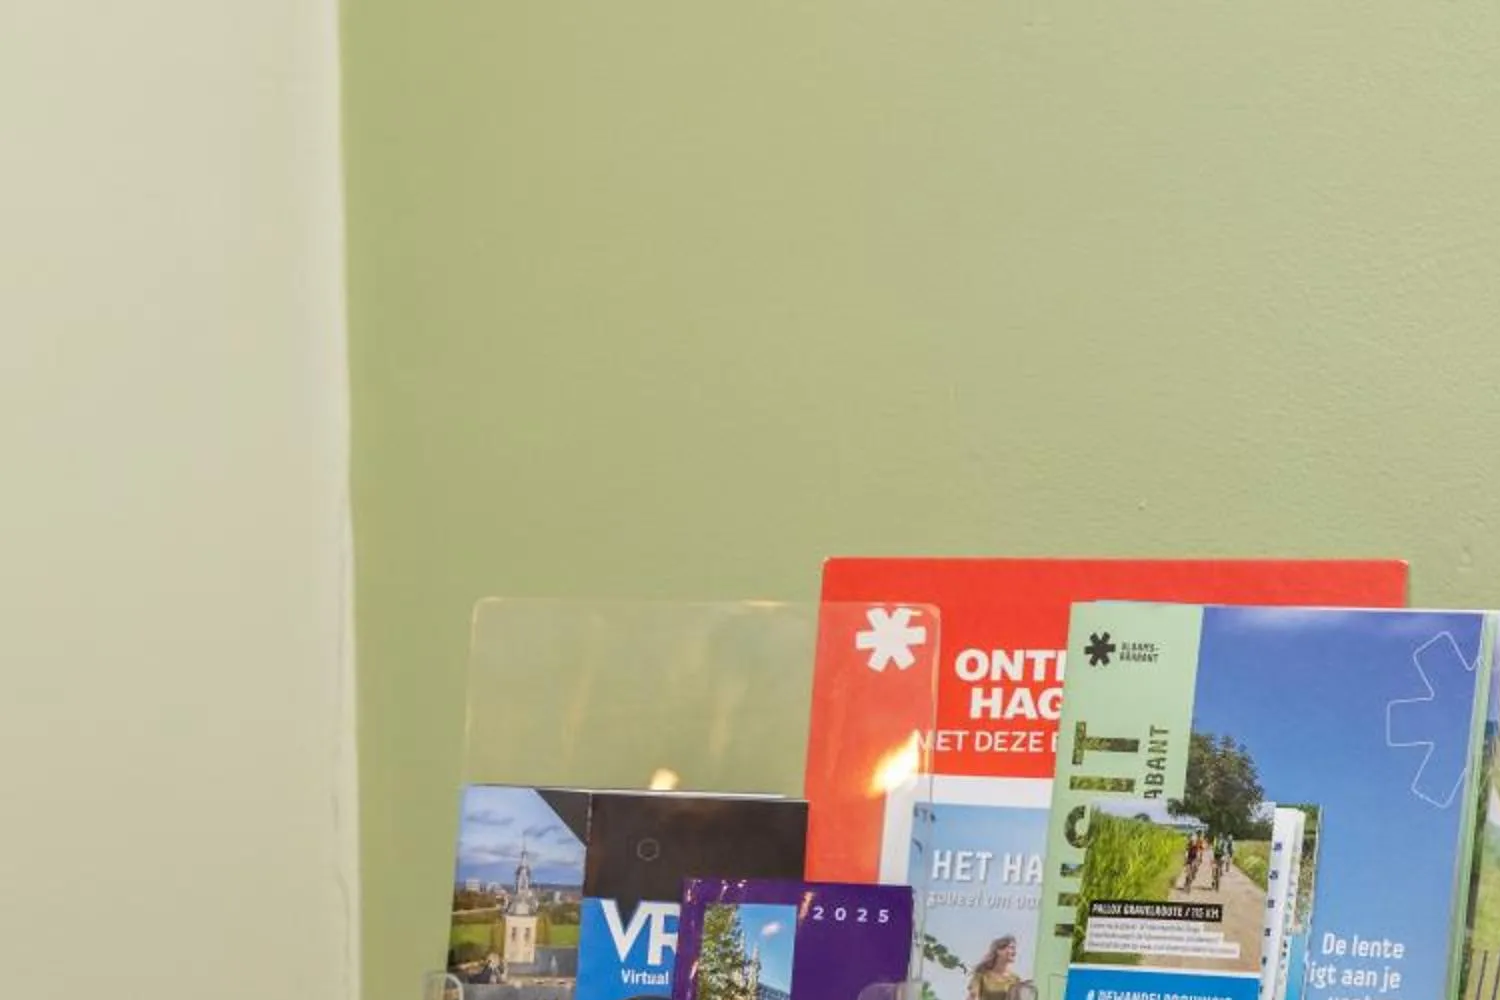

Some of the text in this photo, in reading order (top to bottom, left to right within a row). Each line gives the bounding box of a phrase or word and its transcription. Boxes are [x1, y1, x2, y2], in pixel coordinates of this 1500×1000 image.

[955, 649, 1066, 682] ONT
[974, 731, 1044, 753] DEZE
[932, 849, 993, 881] HET
[812, 905, 889, 923] 2025
[1322, 932, 1405, 960] De lente
[621, 968, 669, 986] Virtual
[1304, 951, 1401, 993] igt aan je
